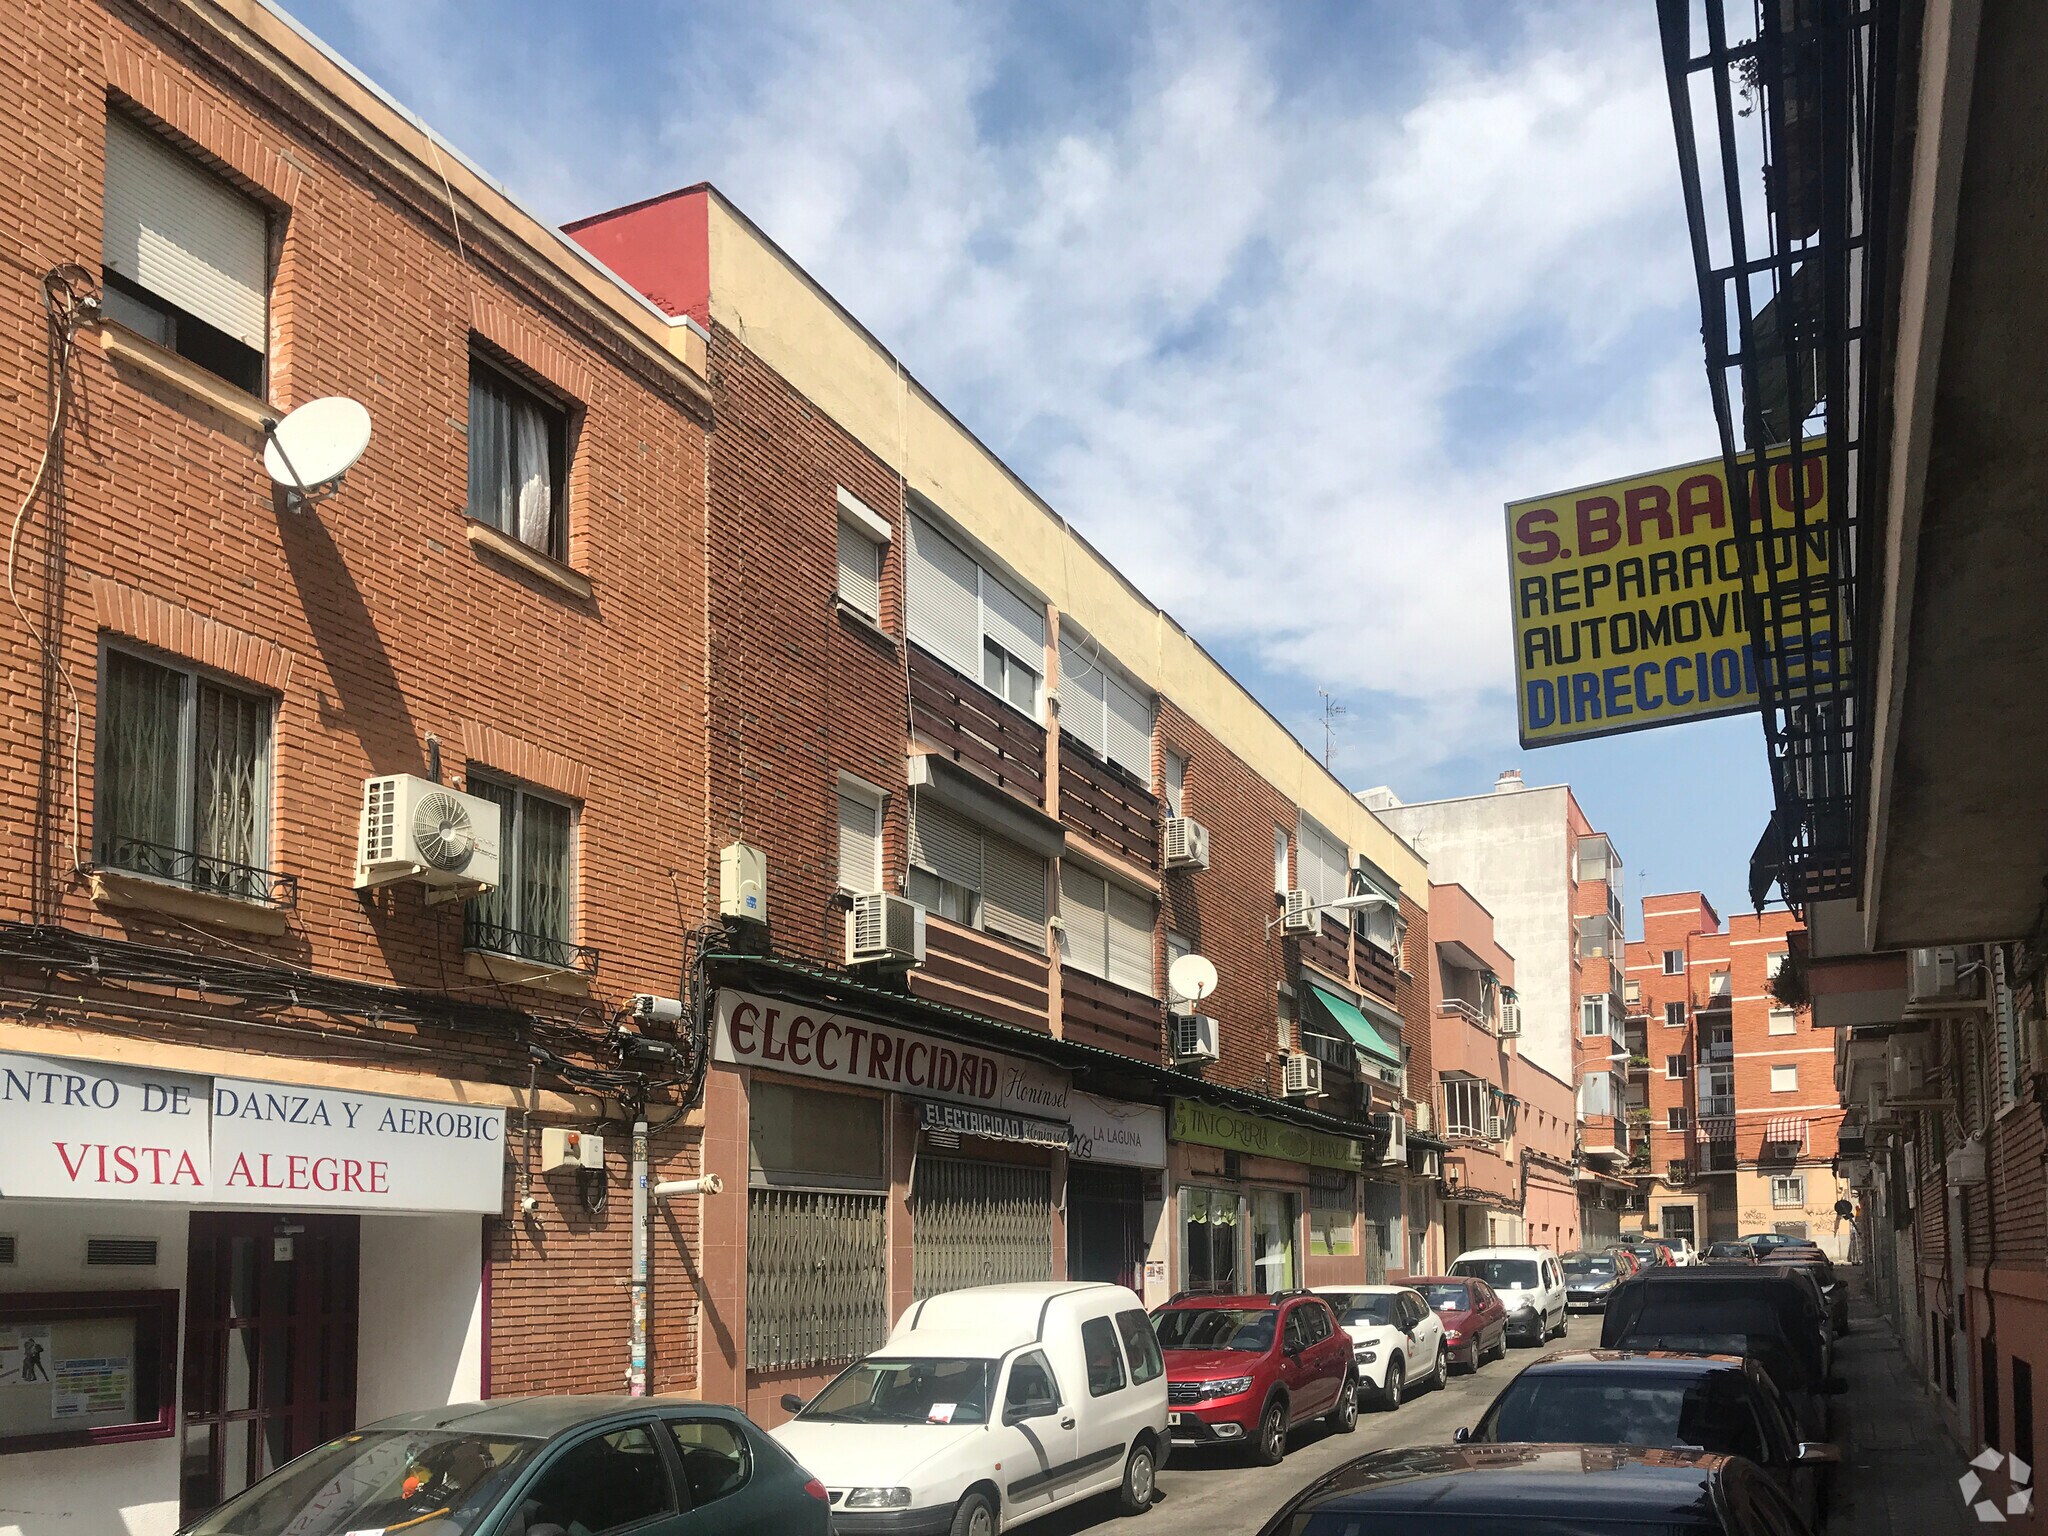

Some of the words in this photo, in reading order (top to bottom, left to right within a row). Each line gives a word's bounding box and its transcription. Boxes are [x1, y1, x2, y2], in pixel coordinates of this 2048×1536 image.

[730, 1002, 998, 1100] ELECTRICIDAD
[1004, 1067, 1071, 1110] Honinsel
[141, 1082, 192, 1115] DE
[215, 1088, 332, 1127] DANZA
[342, 1102, 363, 1128] Y
[377, 1107, 500, 1141] AEROBIC
[926, 1103, 1019, 1139] ELECTRICIDAD
[1093, 1126, 1105, 1142] LA
[1107, 1128, 1142, 1147] LAGUNA
[52, 1142, 204, 1186] VISTA
[225, 1152, 391, 1194] ALEGRE
